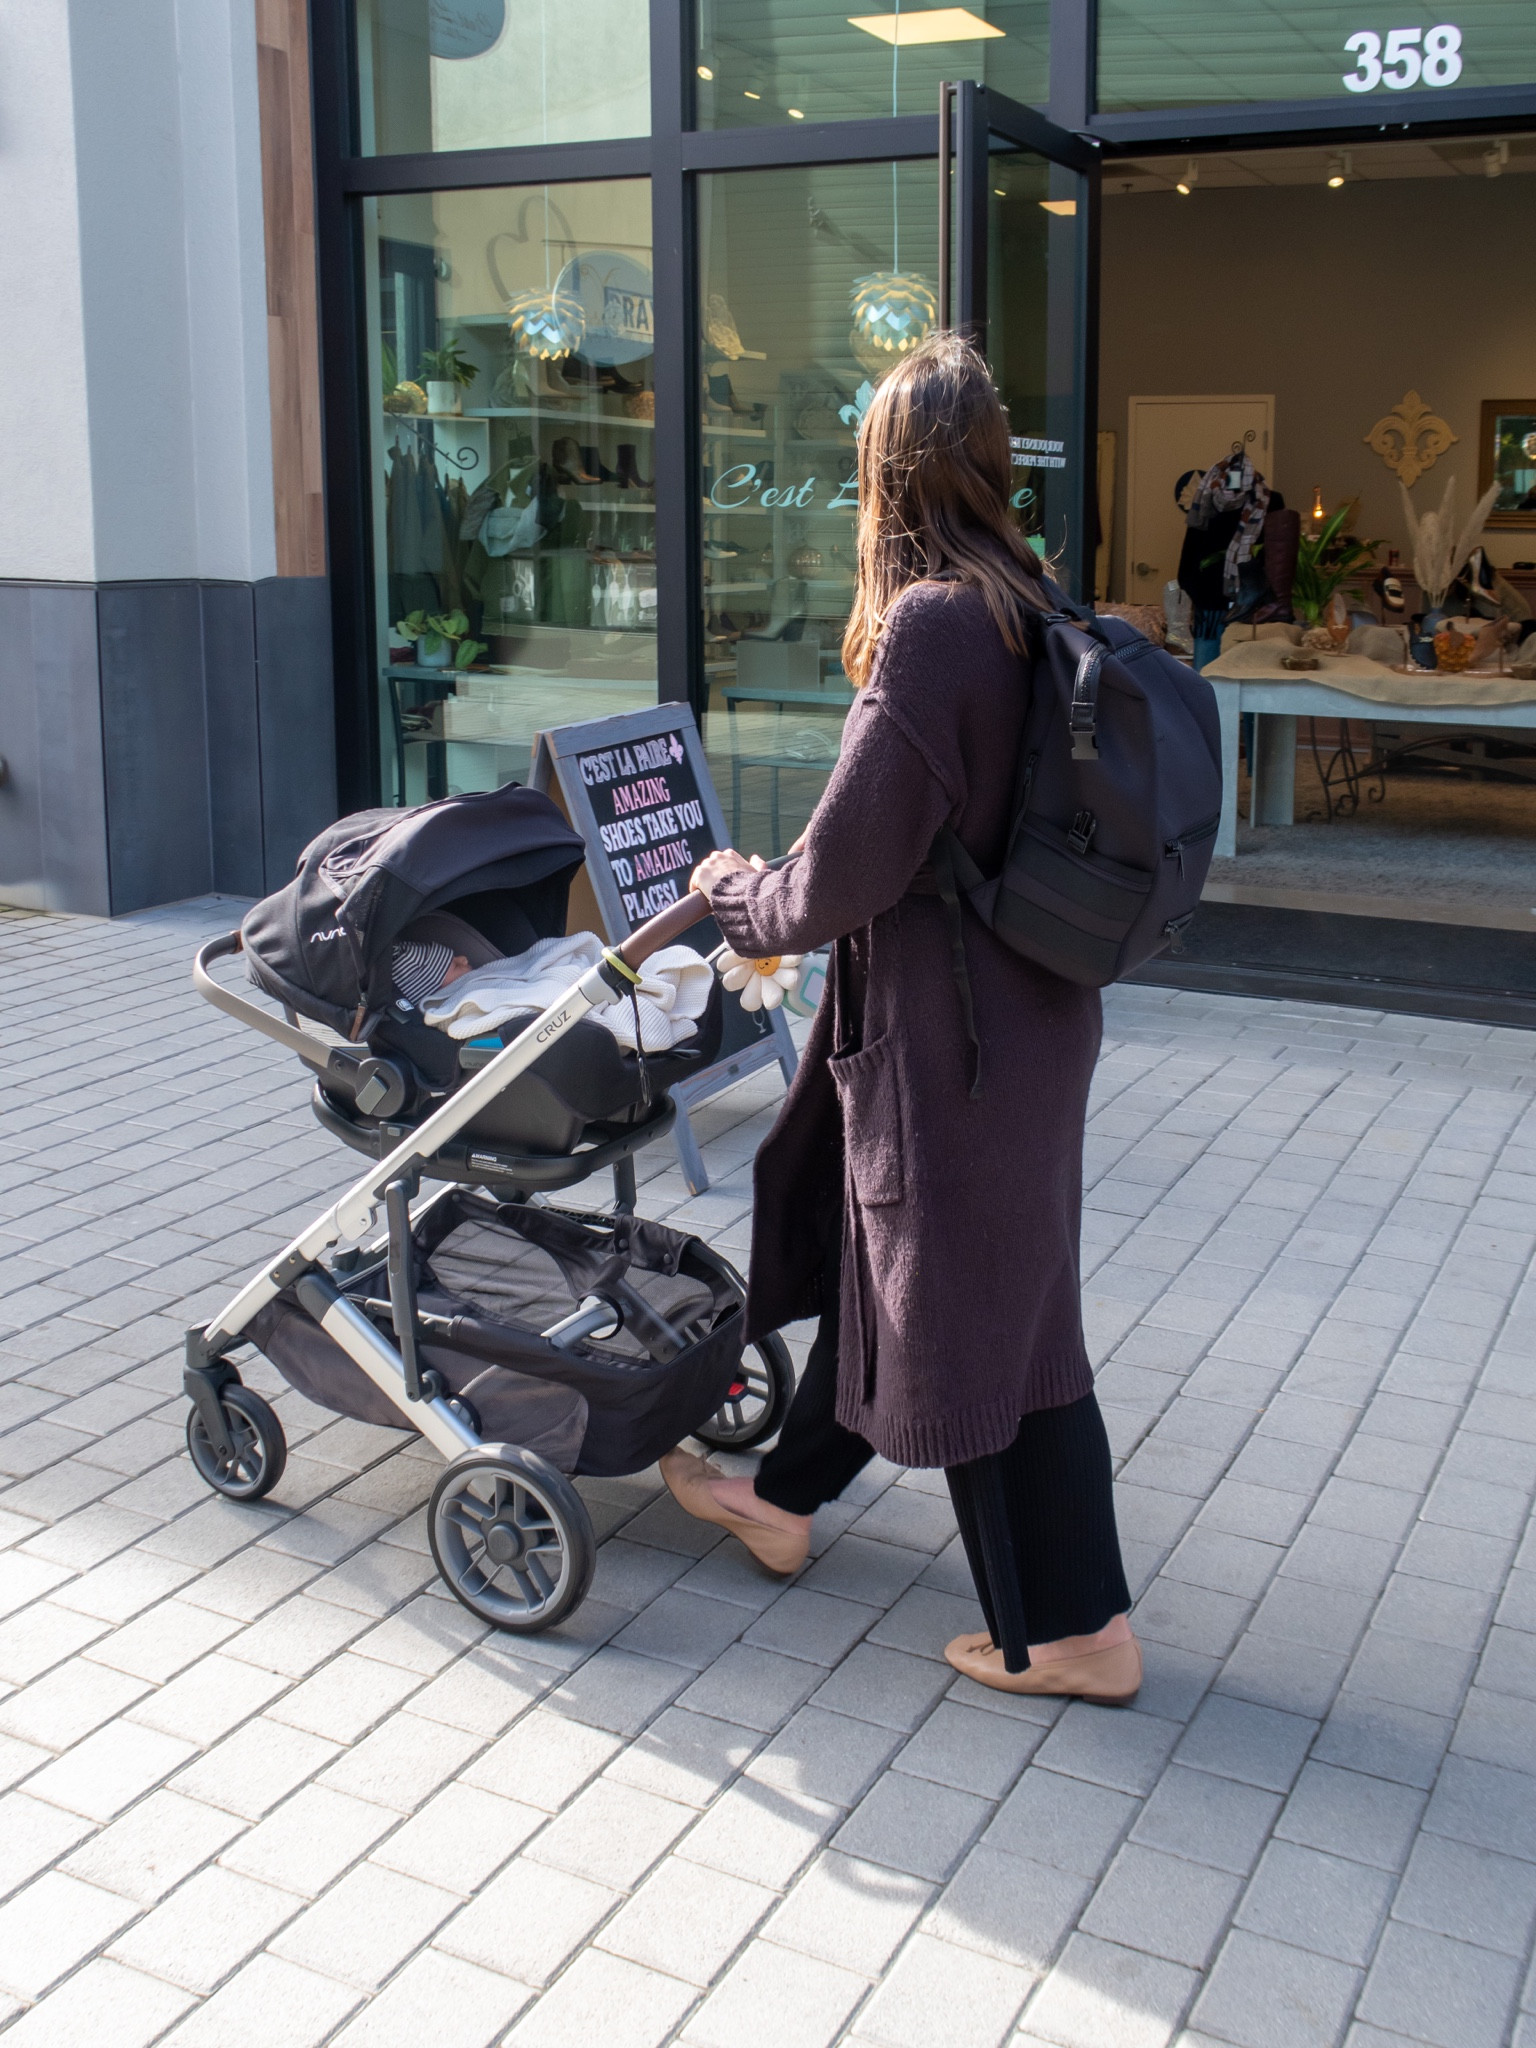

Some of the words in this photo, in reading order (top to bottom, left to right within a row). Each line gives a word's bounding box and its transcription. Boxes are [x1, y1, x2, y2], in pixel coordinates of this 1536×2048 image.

[1342, 24, 1462, 93] 358
[711, 463, 816, 509] C'est
[827, 467, 859, 509] L
[580, 751, 618, 786] C'EST
[613, 747, 637, 776] LA
[633, 738, 672, 771] PAIRE
[612, 777, 671, 815] AMAZING
[600, 817, 646, 852] SHOES
[642, 808, 679, 841] TAKE
[673, 800, 704, 831] YOU
[611, 858, 634, 887] TO
[634, 839, 693, 881] AMAZING
[622, 879, 679, 921] PLACES!
[536, 1010, 571, 1043] CRUZ
